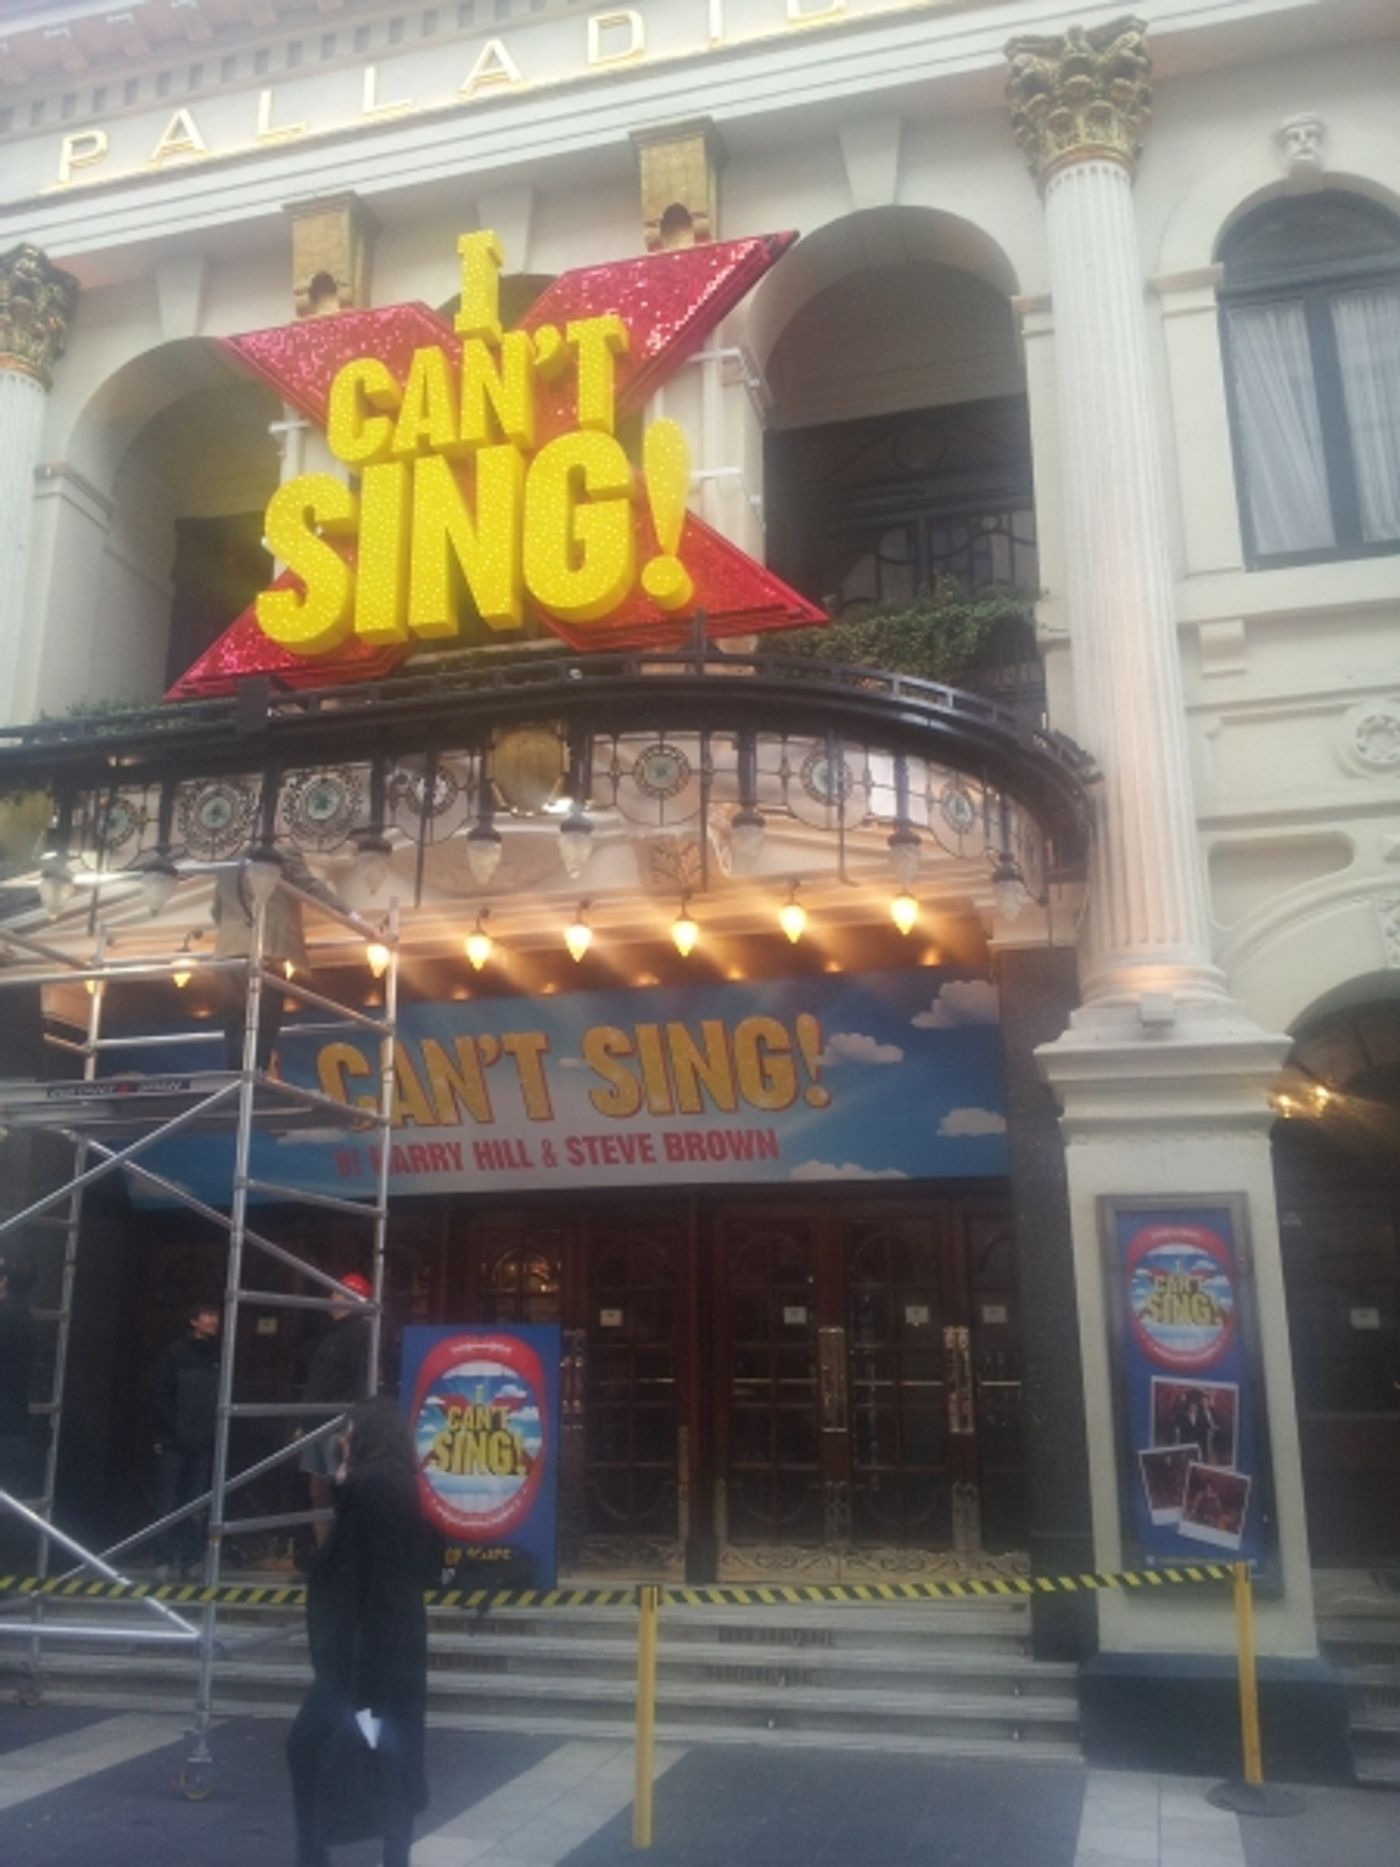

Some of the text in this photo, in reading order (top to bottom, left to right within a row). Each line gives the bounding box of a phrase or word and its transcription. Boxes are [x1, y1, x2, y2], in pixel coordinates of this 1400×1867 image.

[454, 229, 506, 346] I
[327, 313, 631, 468] CAN'T
[255, 417, 695, 655] SING!
[316, 1012, 832, 1132] CAN'T SING!
[472, 1136, 534, 1171] HILL
[541, 1138, 558, 1168] &
[564, 1133, 657, 1167] STEVE
[662, 1128, 780, 1163] BROWN
[1141, 1292, 1223, 1326] SING!
[427, 1430, 528, 1476] SING!
